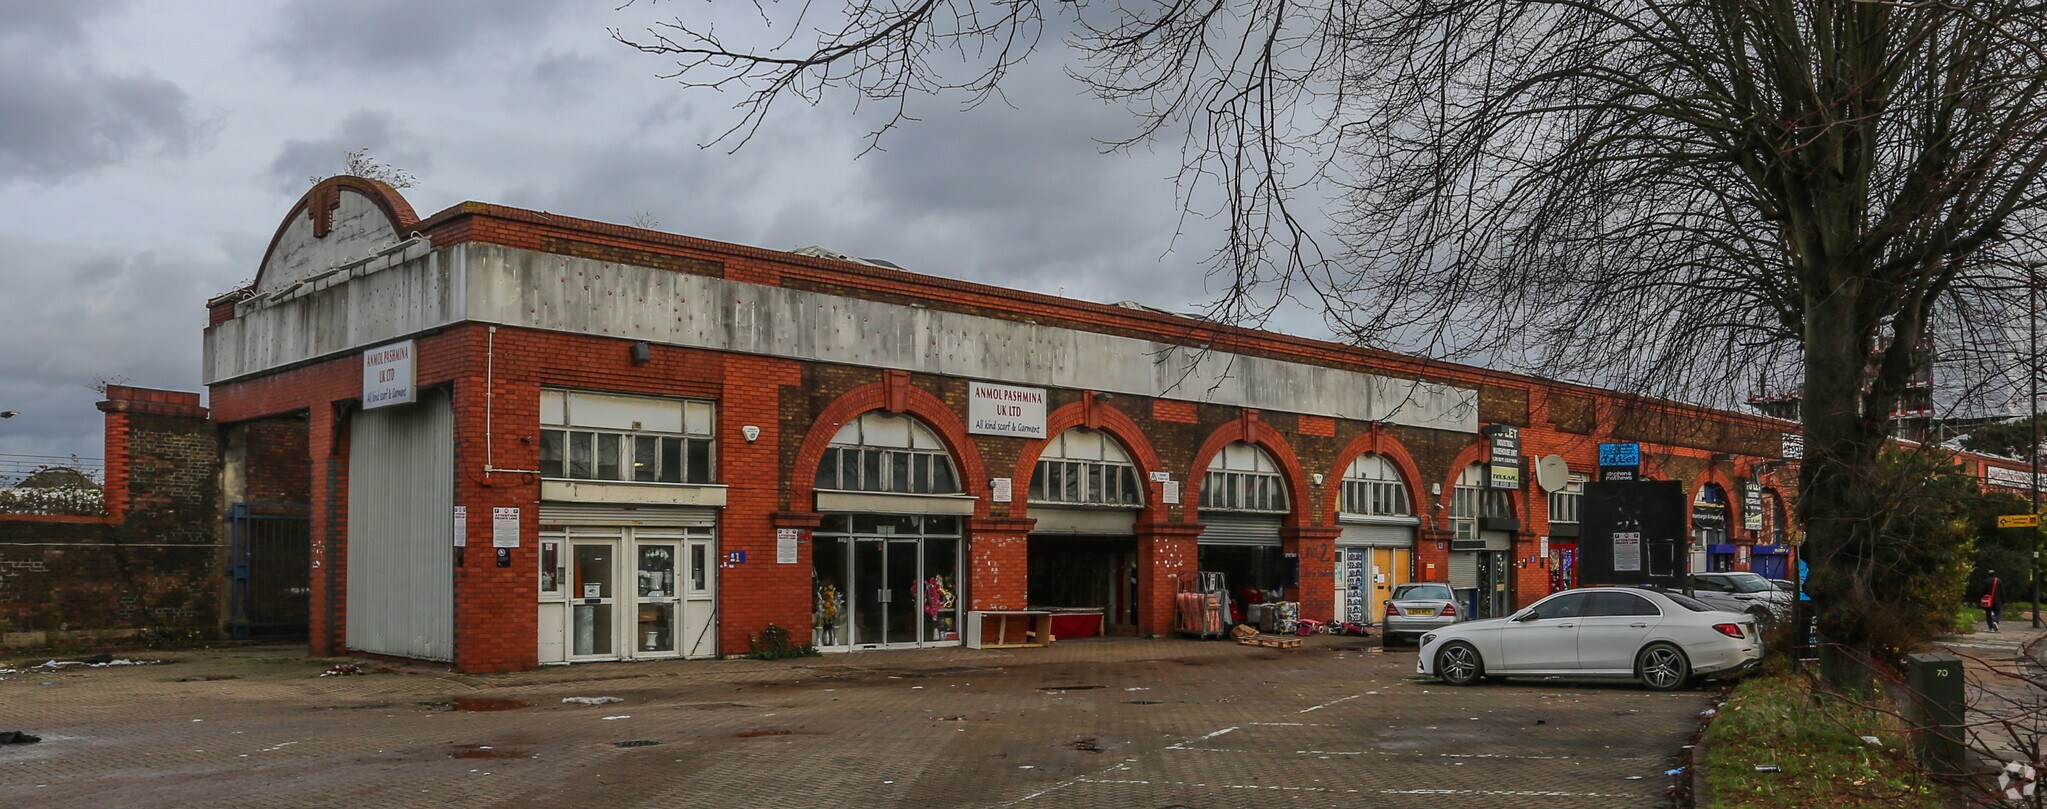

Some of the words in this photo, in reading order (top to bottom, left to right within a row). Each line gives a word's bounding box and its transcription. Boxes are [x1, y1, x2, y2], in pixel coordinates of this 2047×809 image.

[367, 352, 384, 367] ANMOL
[384, 346, 408, 363] PASHMINA
[386, 368, 395, 381] LTD
[975, 387, 1003, 400] ANMOL
[1004, 390, 1042, 404] PASHMINA
[997, 405, 1007, 416] UK
[1009, 405, 1022, 417] LTD
[976, 420, 984, 429] All
[985, 420, 997, 430] kind
[997, 421, 1011, 431] scarf
[1012, 423, 1016, 432] &
[1018, 423, 1040, 434] Garment
[1319, 543, 1331, 562] 2
[1937, 669, 1948, 677] 70
